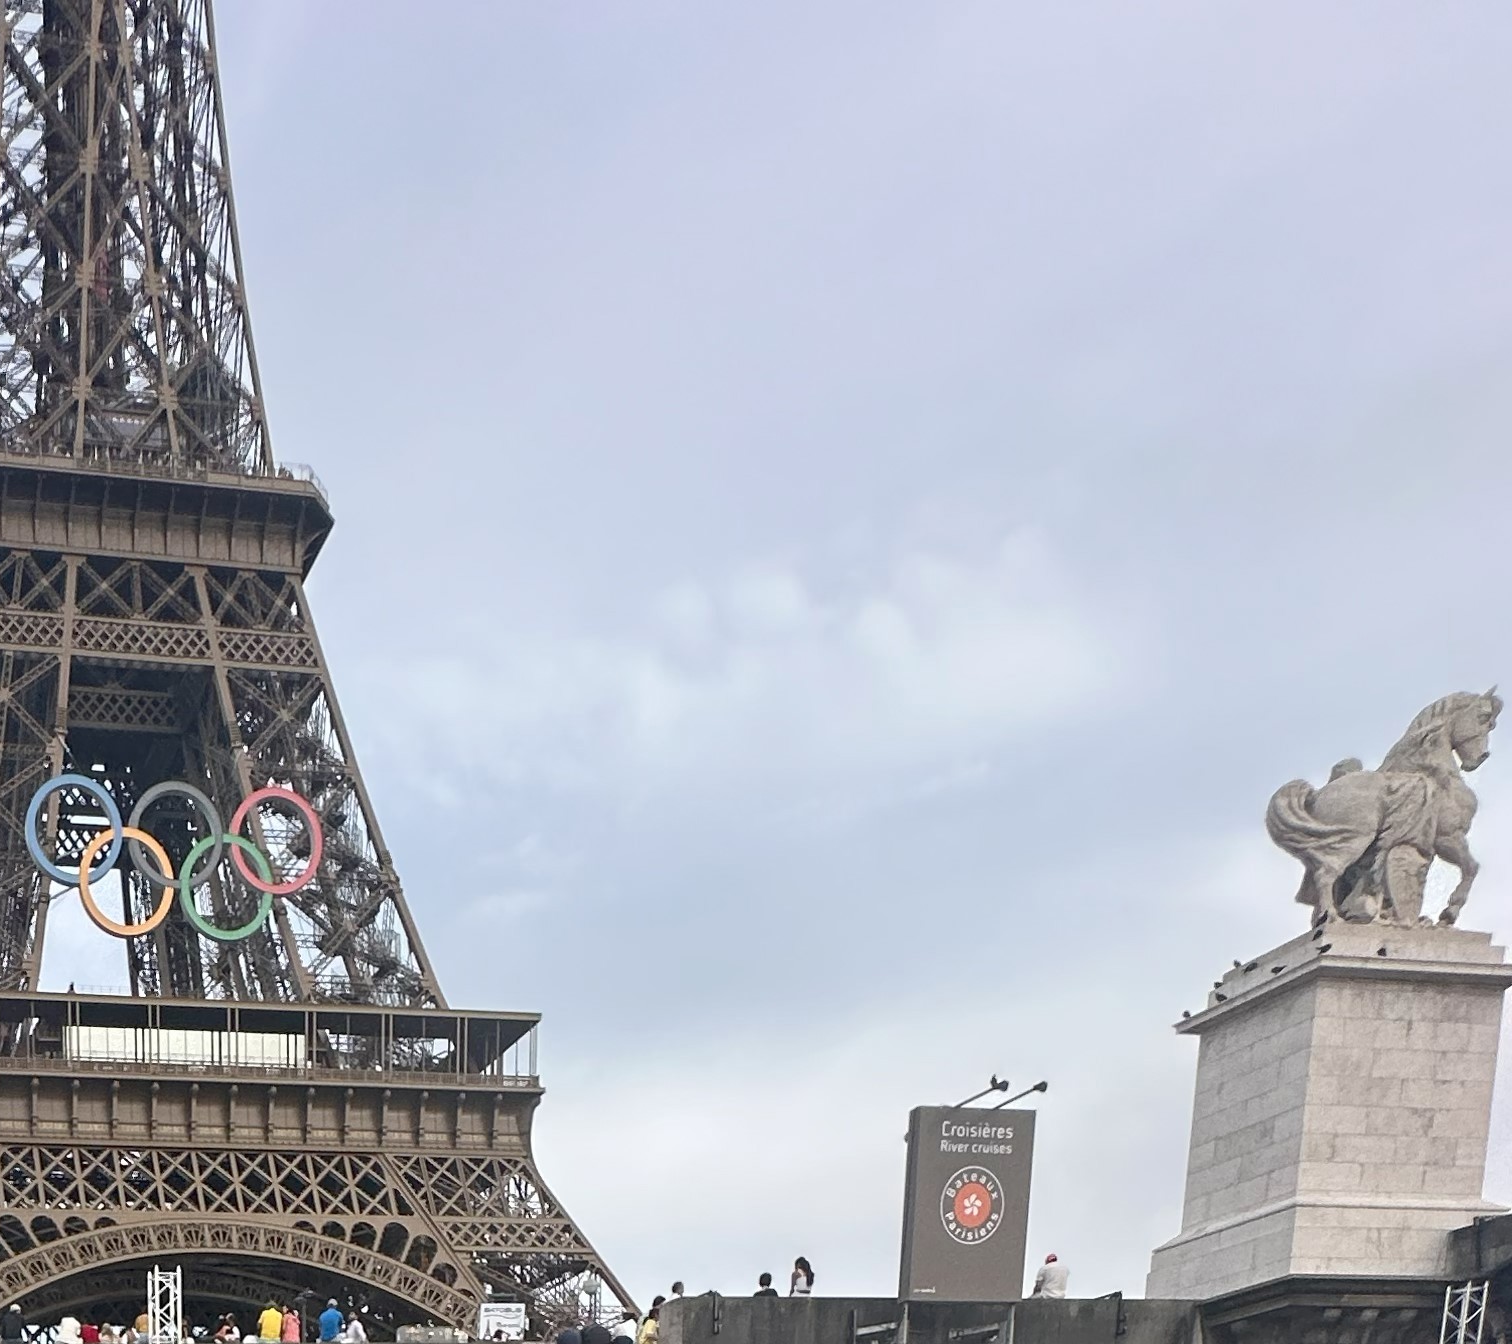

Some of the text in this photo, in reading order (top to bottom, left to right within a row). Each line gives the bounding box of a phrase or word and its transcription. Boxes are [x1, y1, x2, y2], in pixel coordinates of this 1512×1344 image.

[941, 1121, 1014, 1139] Croisières
[940, 1140, 1013, 1155] River cruises
[945, 1171, 999, 1200] Bateaux
[944, 1211, 999, 1241] Parisiens
